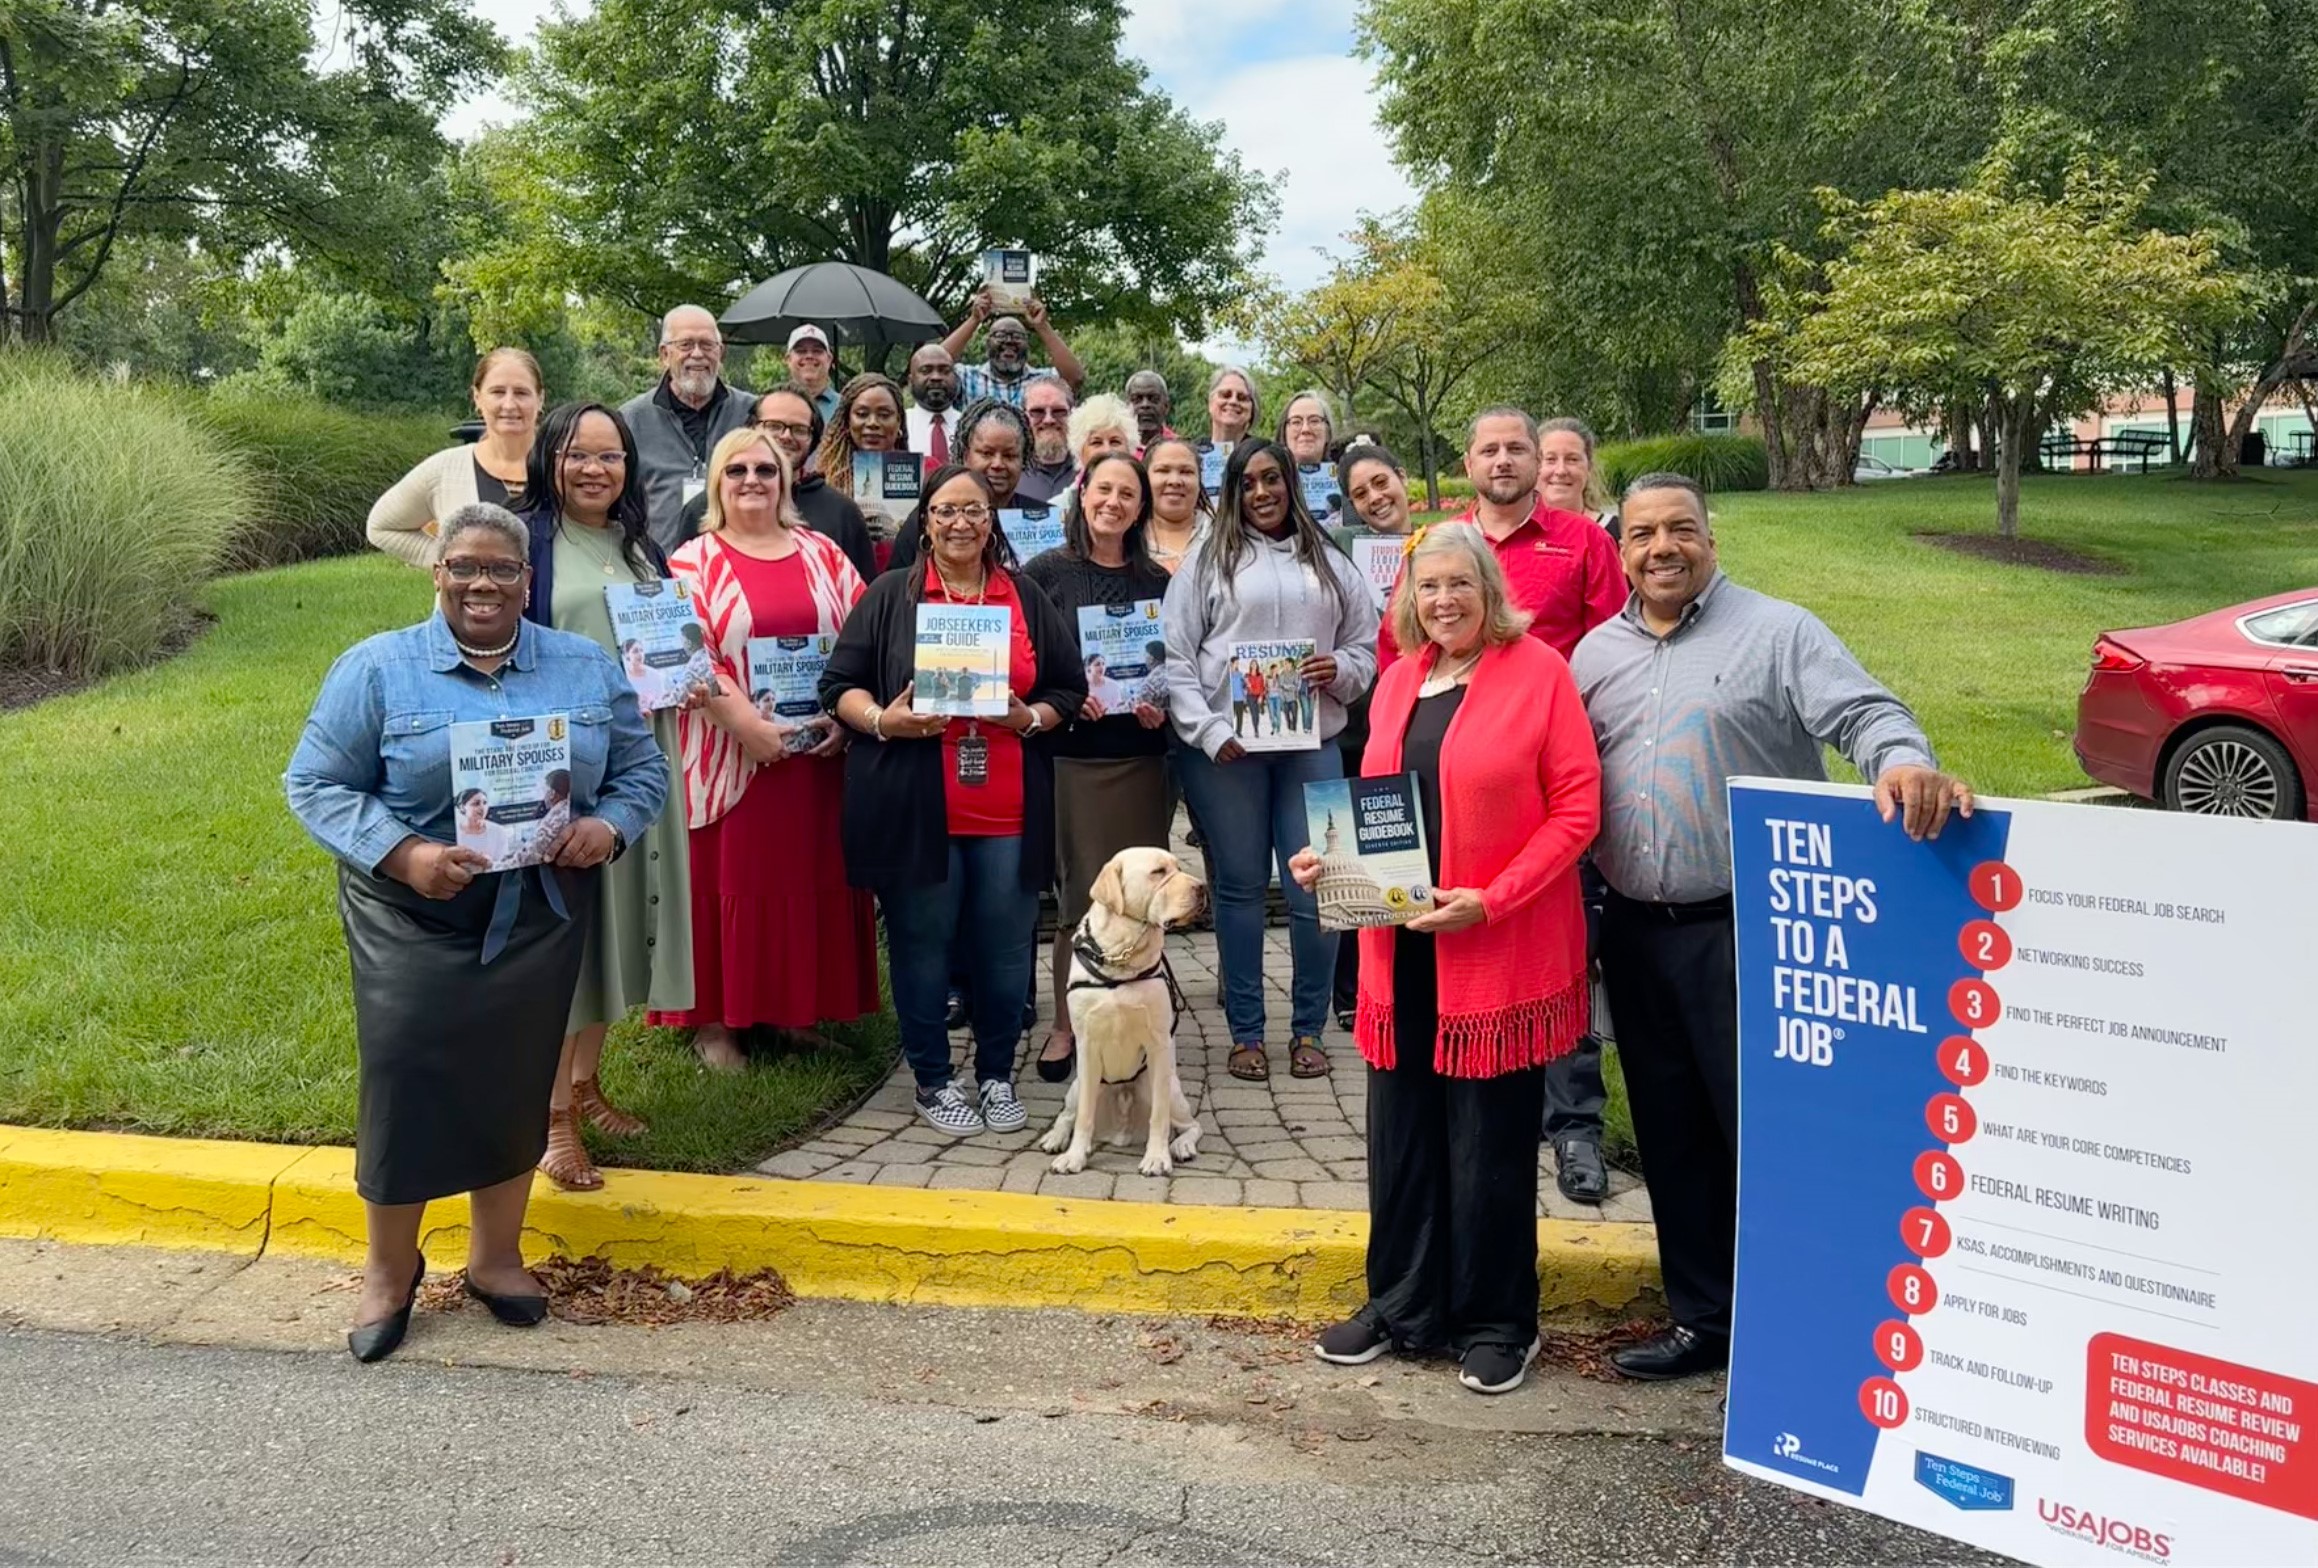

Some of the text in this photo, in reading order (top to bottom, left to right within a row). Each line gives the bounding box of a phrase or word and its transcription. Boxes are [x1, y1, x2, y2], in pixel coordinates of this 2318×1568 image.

[617, 610, 655, 625] MILITARY
[656, 604, 693, 620] SPOUSES
[925, 617, 1002, 633] JOBSEEKER'S
[945, 632, 980, 646] GUIDE
[1084, 628, 1121, 641] MILITARY
[1123, 624, 1160, 638] SPOUSES
[754, 662, 794, 675] MILITARY
[459, 747, 564, 771] MILITARY SPOUSES
[1360, 793, 1405, 811] FEDERAL
[1364, 808, 1405, 825] RESUME
[1359, 822, 1414, 841] GUIDEBOOK
[1765, 818, 1832, 868] TEN
[1769, 868, 1878, 924] STEPS
[1990, 873, 2225, 924] 1 FOCUS YOUR FEDERAL JOB SEARCH
[1770, 916, 1849, 970] TO A
[1977, 931, 2144, 977] 2 NETWORKING SUCCESS
[1773, 965, 1927, 1034] FEDERAL
[1966, 989, 2228, 1052] 3 FIND THE PERFECT JOB ANNOUNCEMENT
[1954, 1048, 2107, 1096] 4 FIND THE KEYWORDS
[1943, 1104, 2192, 1174] 5 WHAT ARE YOUR CORE COMPETENCIES
[1931, 1161, 2160, 1230] 6 FEDERAL RESUME WRITING
[1918, 1218, 2216, 1309] 7 KSAS, ACCOMPLISHMENTS AND QUESTIONNAIRE
[1904, 1275, 2027, 1327] 8 APPLY FOR JOBS
[1890, 1331, 2053, 1395] 9 TRACK AND FOLLOW-UP
[2111, 1352, 2293, 1416] TEN STEPS CLASSES AND
[1872, 1387, 2061, 1461] 10 STRUCTURED INTERVIEWING
[2109, 1400, 2286, 1464] AND USAJOBS COACHING
[2110, 1376, 2301, 1443] FEDERAL RESUME REVIEW
[1817, 1460, 1839, 1473] PLACE
[1924, 1457, 1947, 1473] Ten
[1949, 1464, 1980, 1484] Steps
[2108, 1424, 2267, 1484] SERVICES AVAILABLE!
[1935, 1473, 1978, 1496] Federal
[2105, 1542, 2125, 1553] FOR
